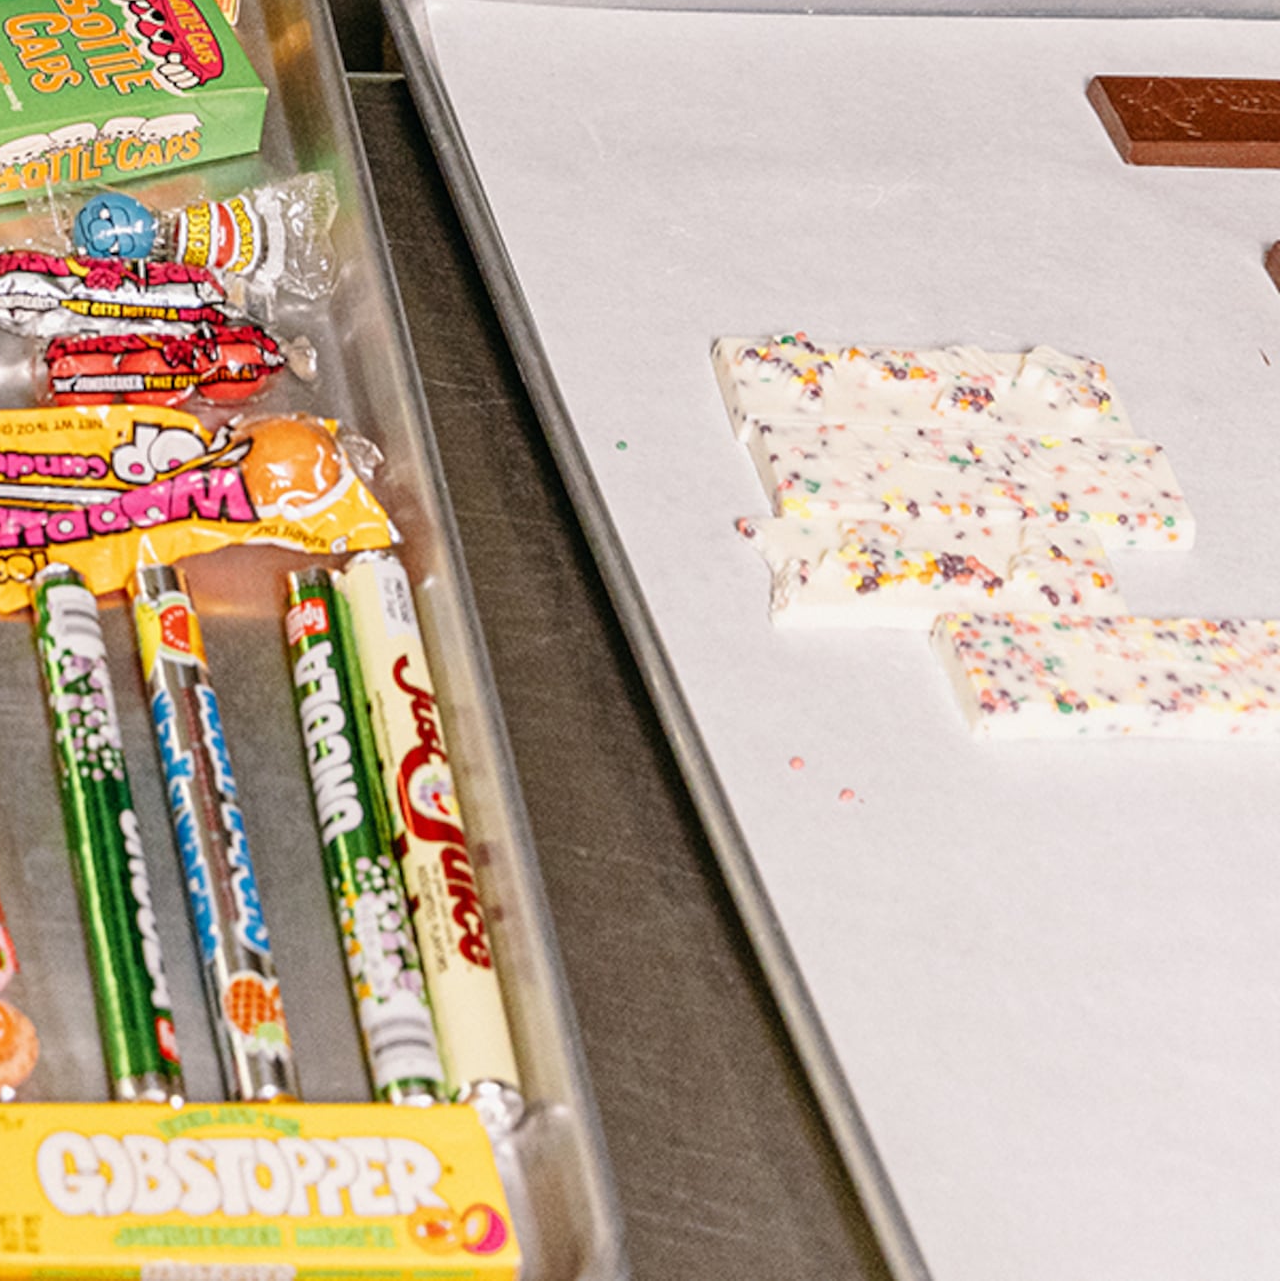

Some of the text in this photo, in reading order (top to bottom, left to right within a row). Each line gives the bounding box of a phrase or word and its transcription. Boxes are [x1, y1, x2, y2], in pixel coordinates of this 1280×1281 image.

[2, 11, 86, 94] CAPS
[115, 130, 201, 172] CAPS
[90, 302, 122, 319] GETS
[294, 640, 364, 847] UNCOLA
[392, 654, 446, 764] Just
[397, 744, 493, 970] Juice
[36, 1130, 452, 1216] GOBSTOPPER
